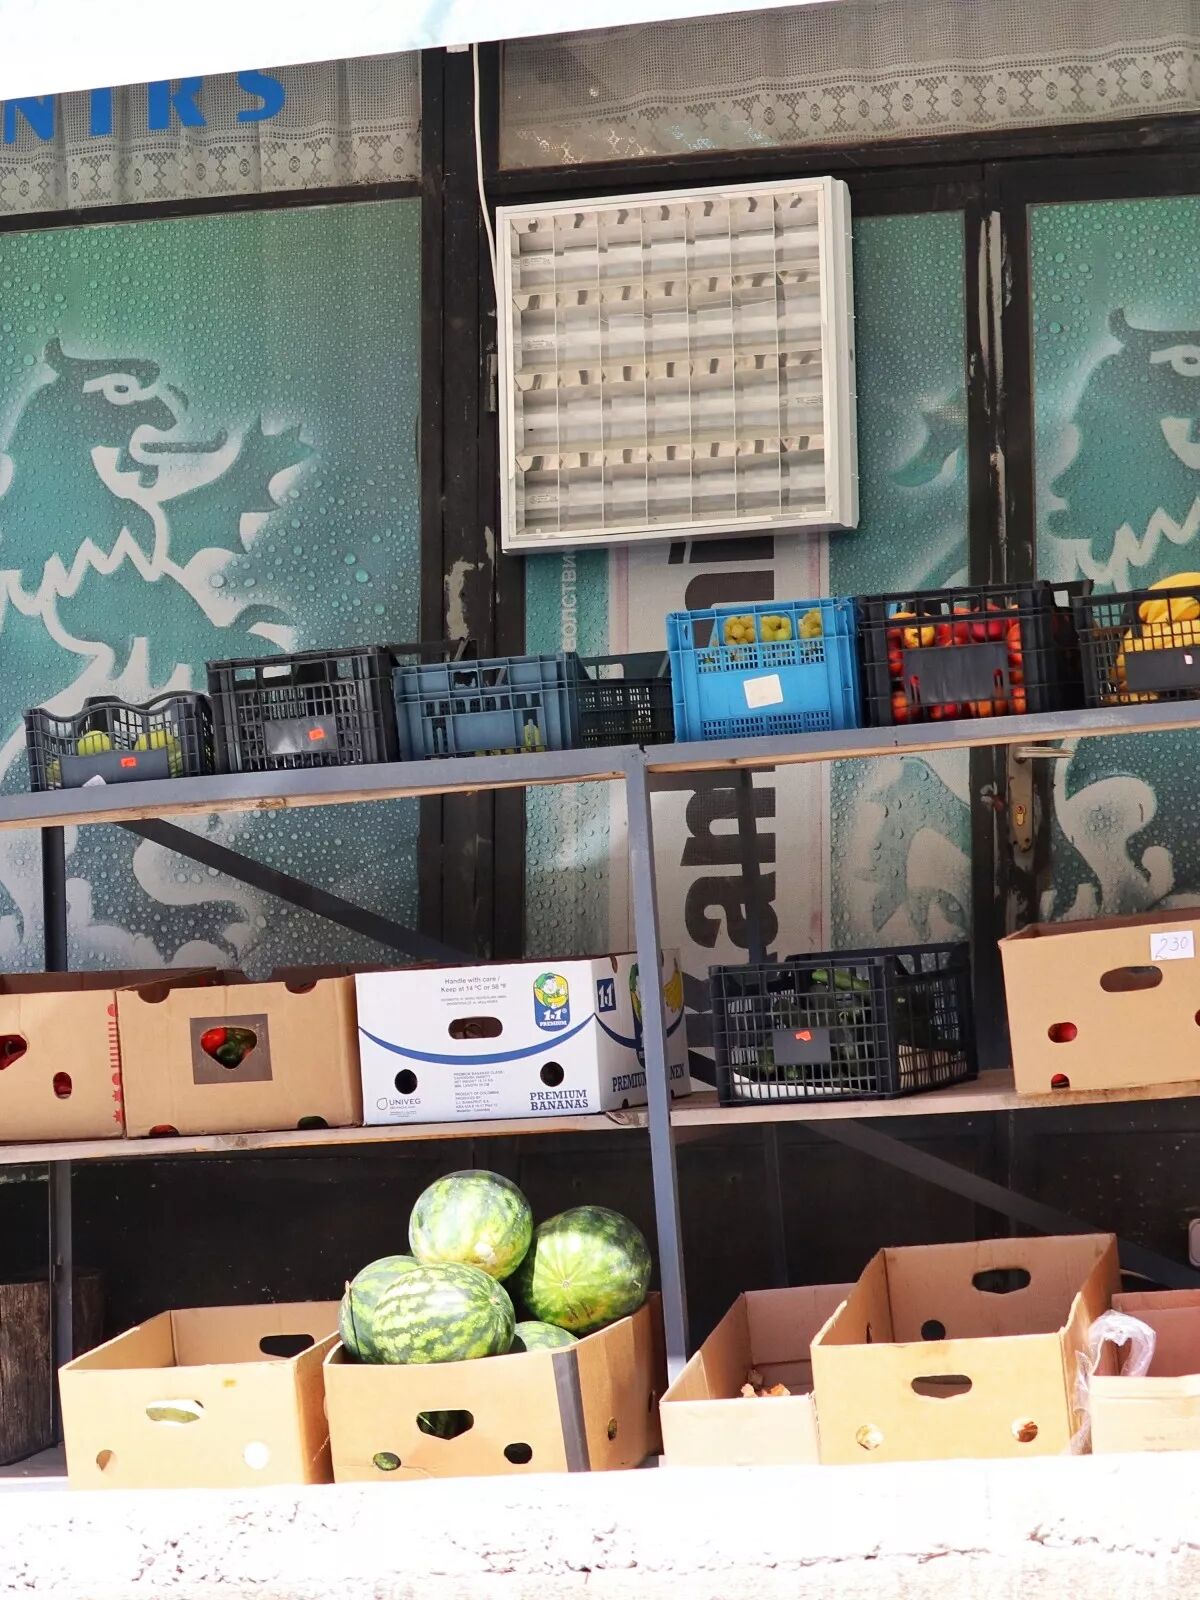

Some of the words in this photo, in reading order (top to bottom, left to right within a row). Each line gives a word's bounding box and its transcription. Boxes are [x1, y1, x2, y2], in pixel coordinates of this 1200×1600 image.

[444, 977, 467, 985] Handle
[467, 976, 481, 984] with
[530, 1089, 587, 1100] PREMIUM
[389, 1098, 421, 1106] UNIVEG
[530, 1099, 589, 1111] BANANAS
